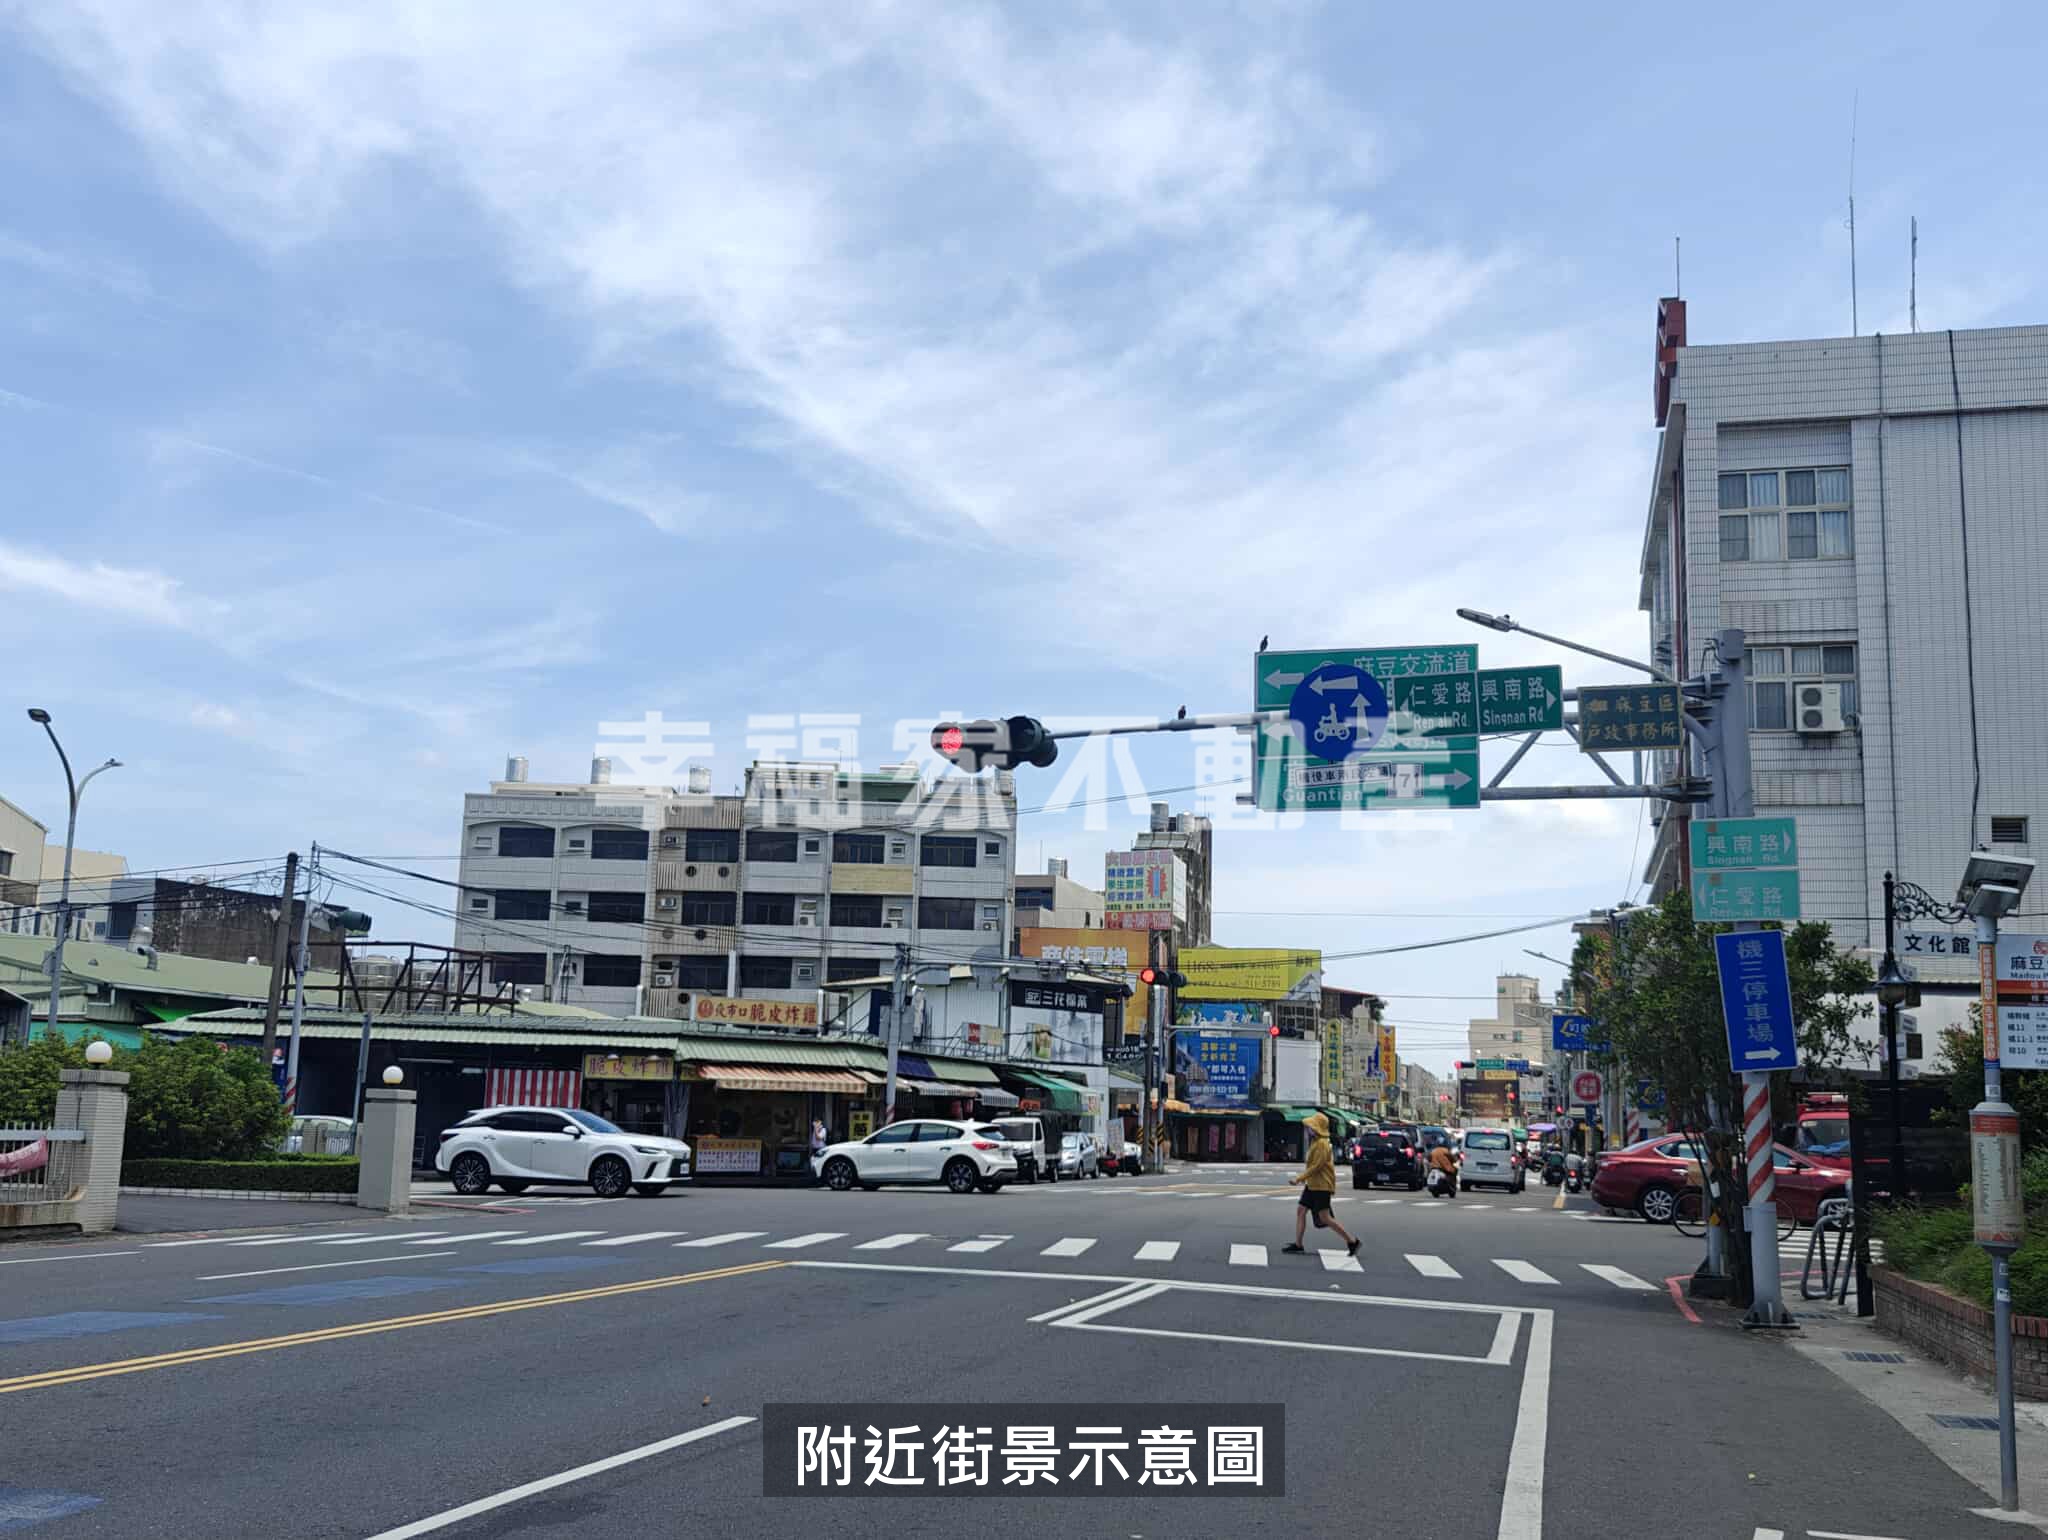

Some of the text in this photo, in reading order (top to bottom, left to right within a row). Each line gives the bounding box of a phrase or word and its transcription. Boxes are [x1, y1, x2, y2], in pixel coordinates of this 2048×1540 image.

[1408, 680, 1473, 706] 仁愛路
[1481, 676, 1546, 702] 興南路
[1482, 709, 1527, 727] Singnan
[1282, 786, 1364, 803] Guantian
[1707, 833, 1781, 854] 興南路
[1711, 887, 1783, 906] 仁愛路
[1903, 933, 1971, 955] 文化館
[2010, 955, 2048, 971] 麻豆
[1736, 939, 1774, 1042] 機三停車場
